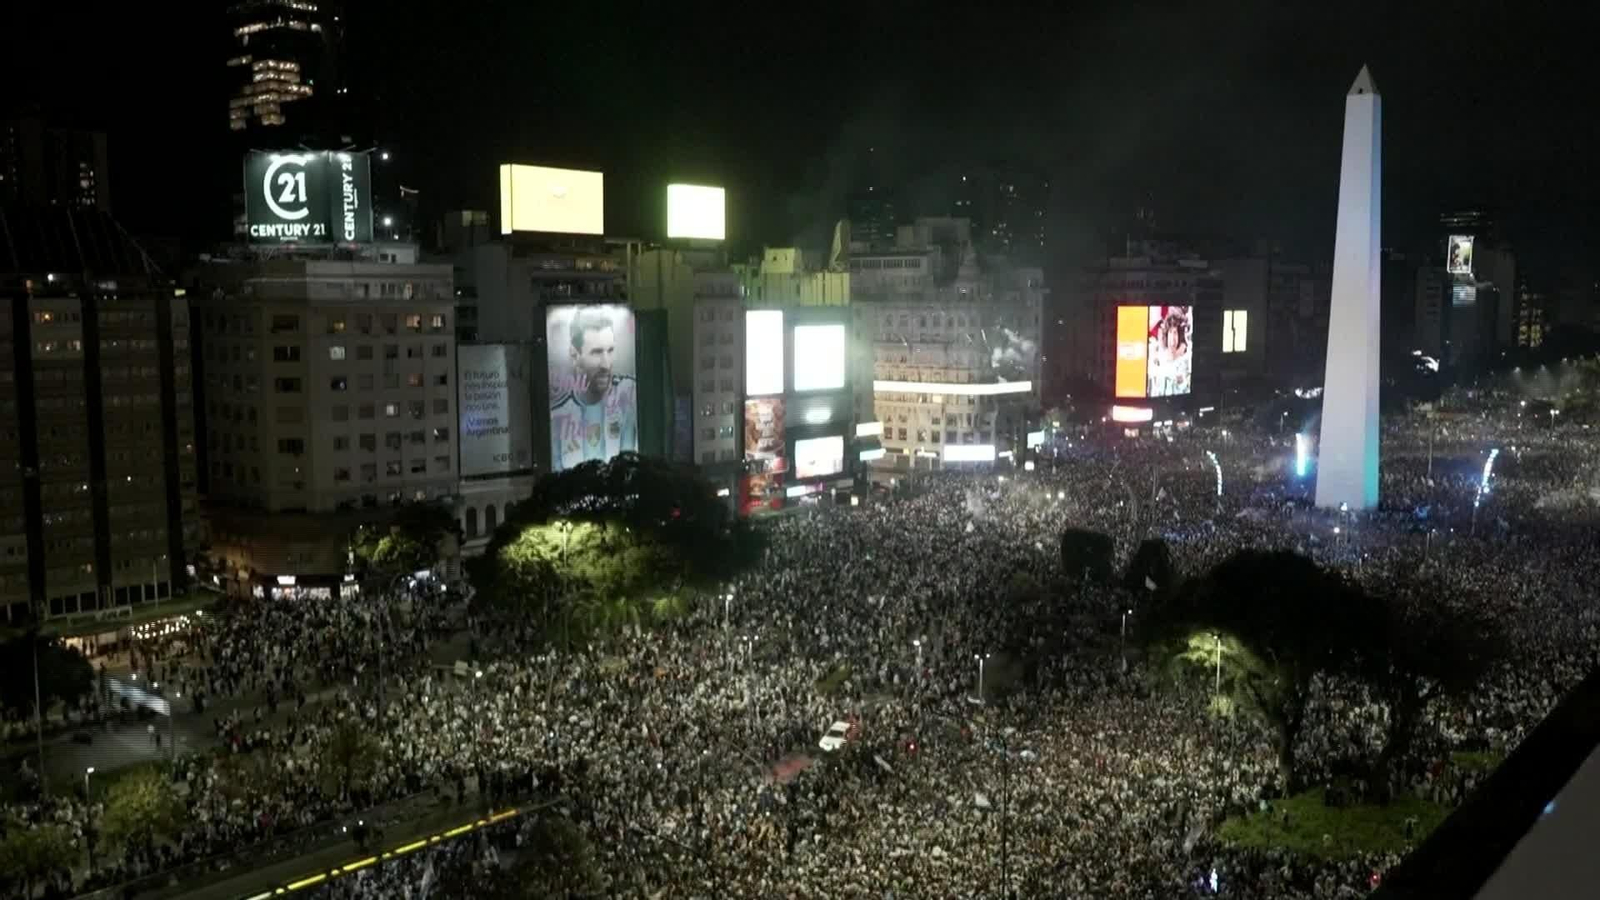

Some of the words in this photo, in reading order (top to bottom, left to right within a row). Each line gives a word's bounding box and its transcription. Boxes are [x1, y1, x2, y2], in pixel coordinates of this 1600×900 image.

[277, 171, 307, 203] 21
[342, 173, 355, 240] CENTURY
[250, 223, 310, 237] CENTURY
[313, 223, 326, 236] 21
